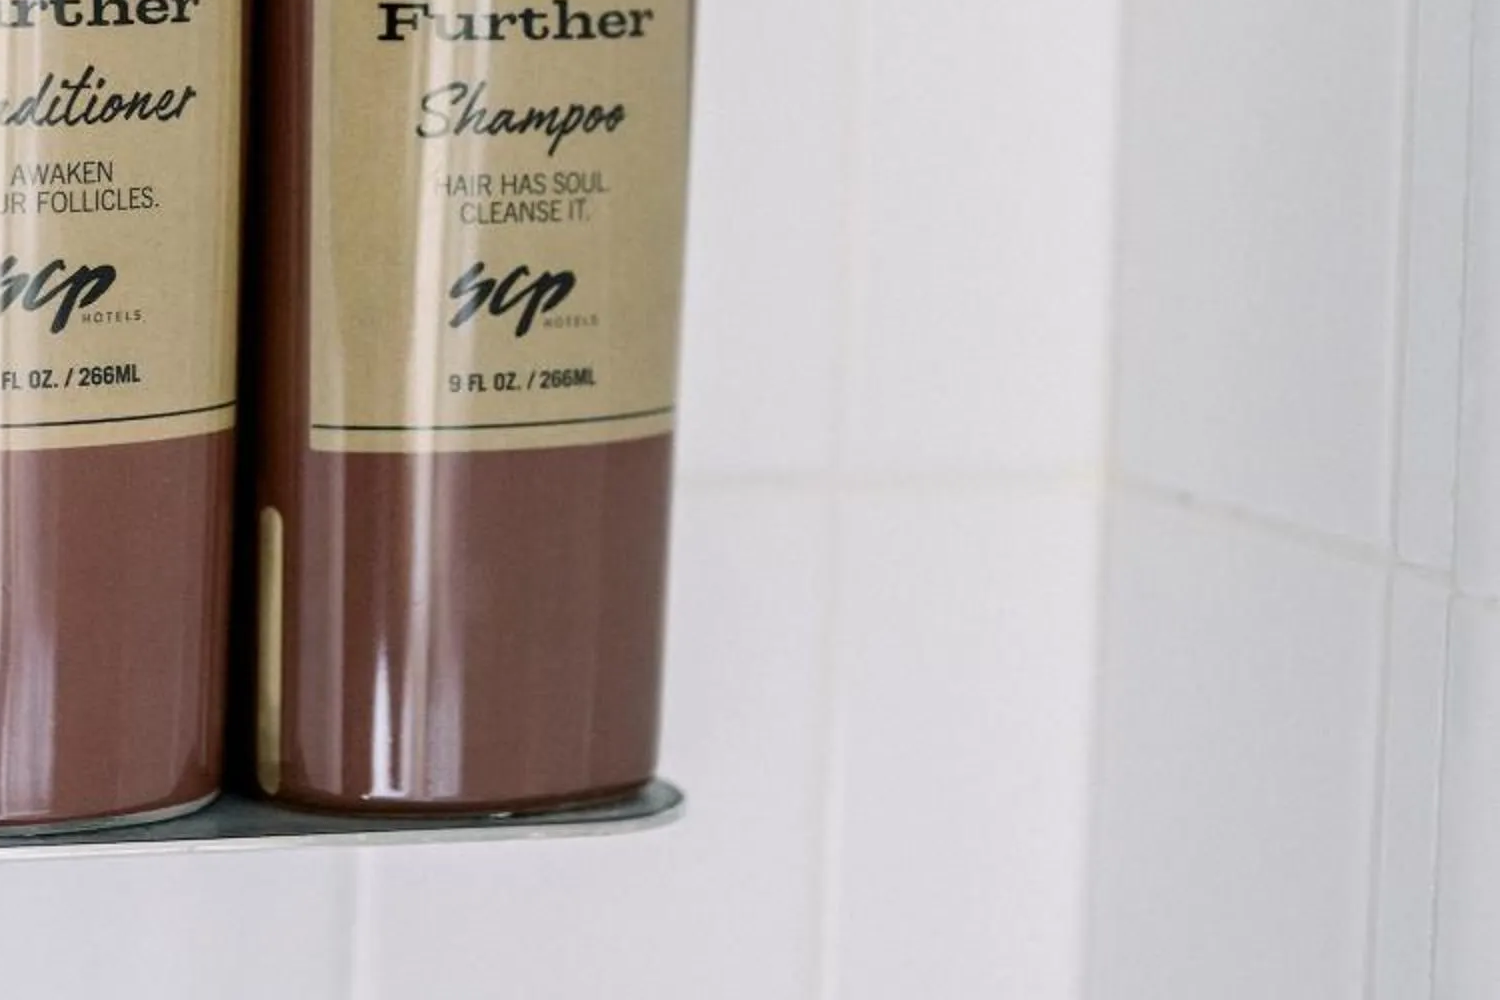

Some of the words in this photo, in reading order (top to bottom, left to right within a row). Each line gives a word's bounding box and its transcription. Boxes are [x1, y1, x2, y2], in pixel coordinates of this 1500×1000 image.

[415, 81, 627, 157] Shampoo
[10, 161, 114, 186] AWAKEN
[434, 173, 492, 197] HAIR
[500, 172, 546, 195] HAS
[553, 169, 611, 195] SOUL
[37, 187, 160, 214] FOLLICLES.
[460, 200, 563, 225] CLEANSE
[449, 261, 577, 338] scp
[1, 371, 20, 390] FL
[29, 369, 59, 389] OZ.
[64, 367, 74, 388] /
[78, 364, 141, 387] 266ML
[449, 374, 461, 393] 9
[467, 373, 487, 393] FL
[526, 370, 536, 390] /
[539, 367, 597, 390] 266ML
